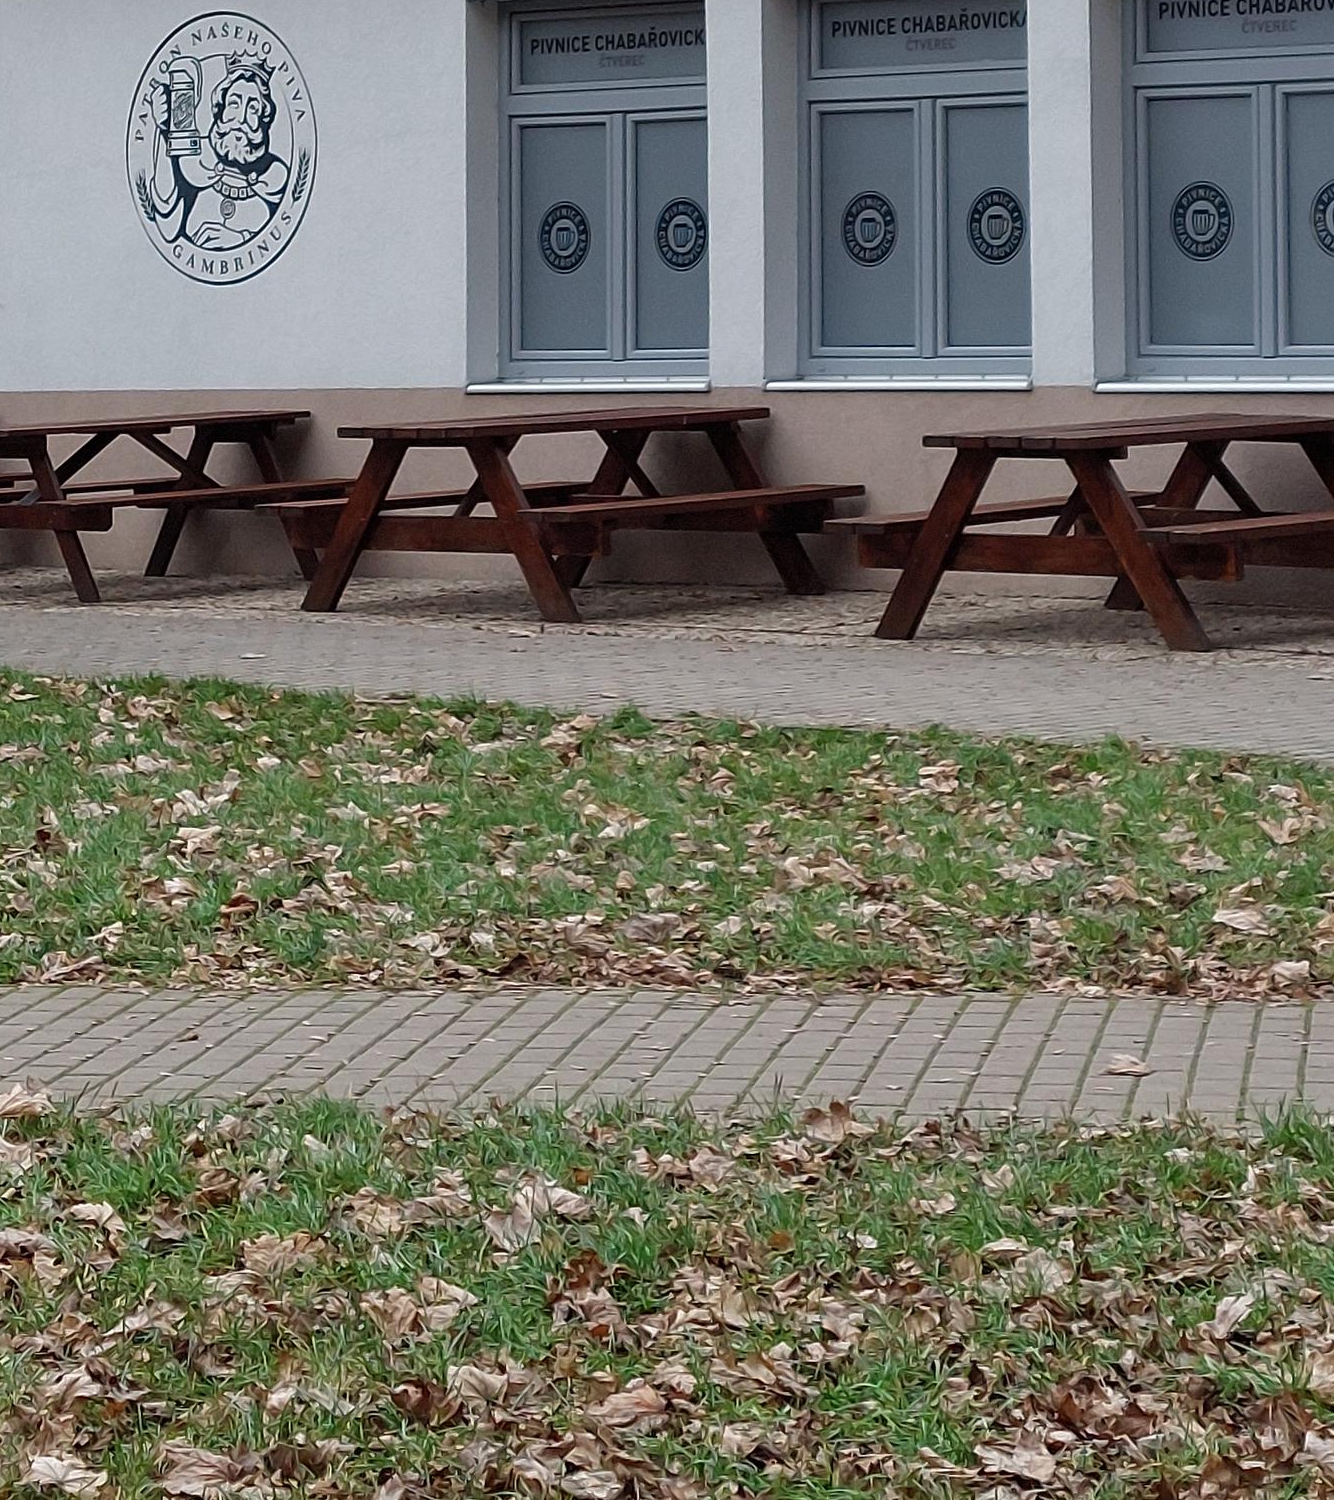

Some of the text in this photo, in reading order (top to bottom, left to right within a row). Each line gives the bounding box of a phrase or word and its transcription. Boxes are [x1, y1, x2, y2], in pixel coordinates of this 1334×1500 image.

[530, 27, 705, 56] PIVNICE CHABAŘOVICK
[831, 18, 896, 38] PIVNICE
[190, 21, 272, 55] NAŠEHO
[277, 60, 306, 122] PIVA
[172, 211, 292, 276] GAMBRINUS
